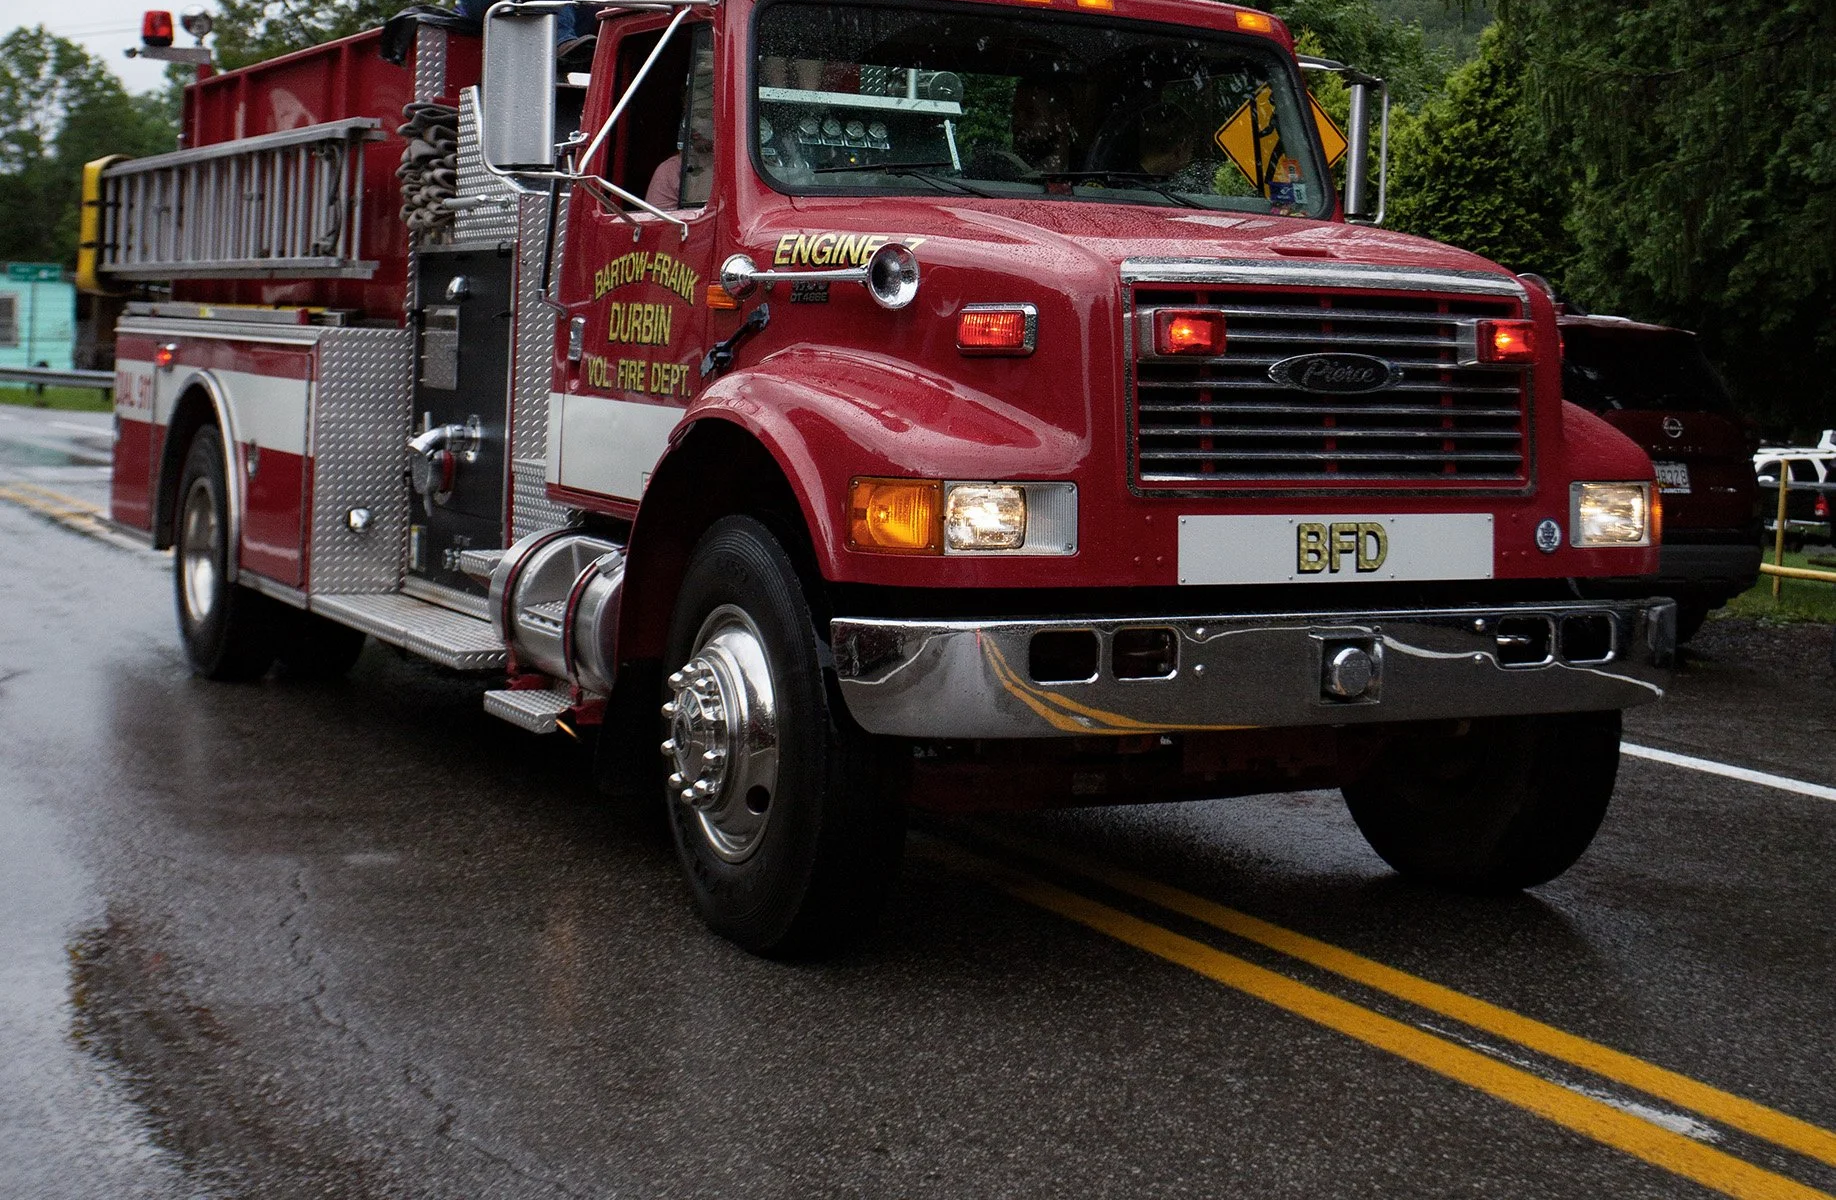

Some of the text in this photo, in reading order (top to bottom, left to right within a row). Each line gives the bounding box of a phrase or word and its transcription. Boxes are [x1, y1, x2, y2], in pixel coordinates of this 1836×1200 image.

[774, 234, 889, 267] ENGINE
[594, 251, 700, 306] BARTOW-FRANK
[608, 302, 672, 346] DURBIN
[617, 358, 646, 392] FIRE
[650, 362, 692, 397] DEPT.
[1301, 358, 1376, 386] Pierce
[1297, 521, 1388, 574] BFD
